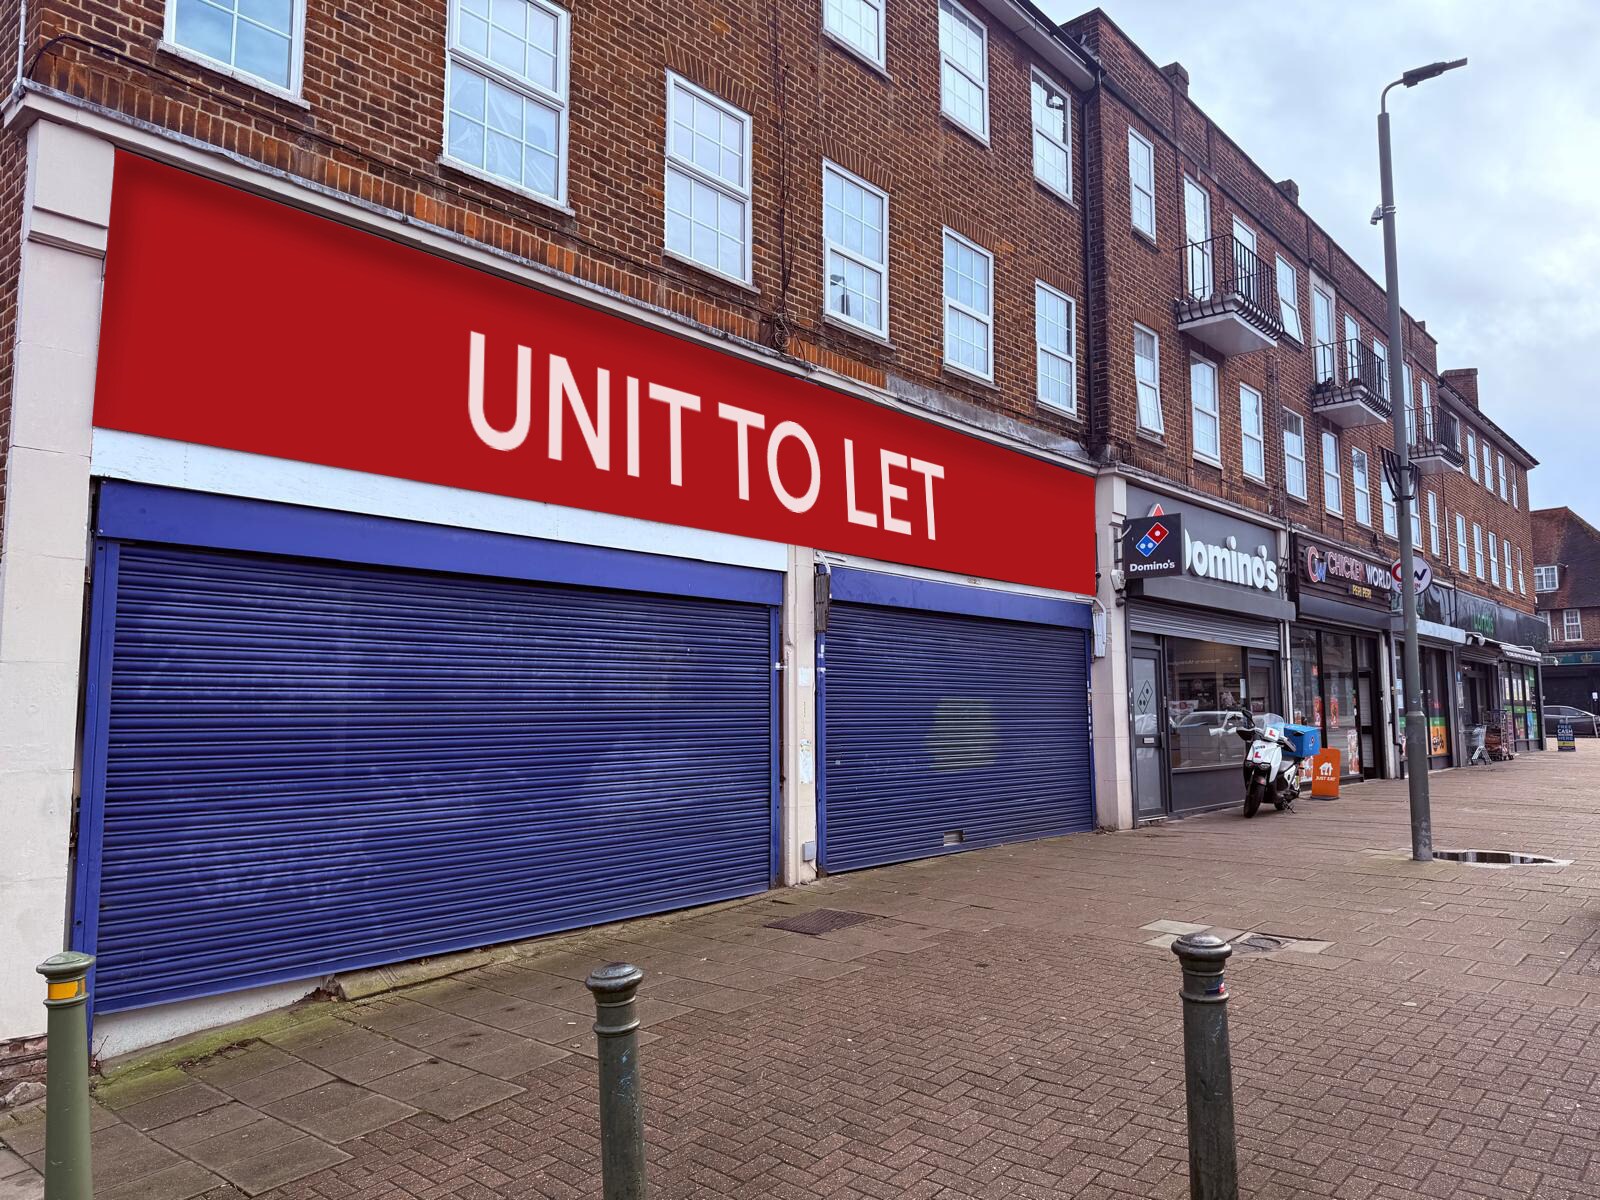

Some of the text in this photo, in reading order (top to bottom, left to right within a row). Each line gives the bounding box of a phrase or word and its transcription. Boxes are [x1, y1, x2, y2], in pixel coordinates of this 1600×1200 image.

[467, 330, 946, 541] UNIT TO LET
[1129, 559, 1176, 572] Domino's
[1326, 551, 1366, 582] CHICKEN
[1365, 563, 1392, 590] WORLD
